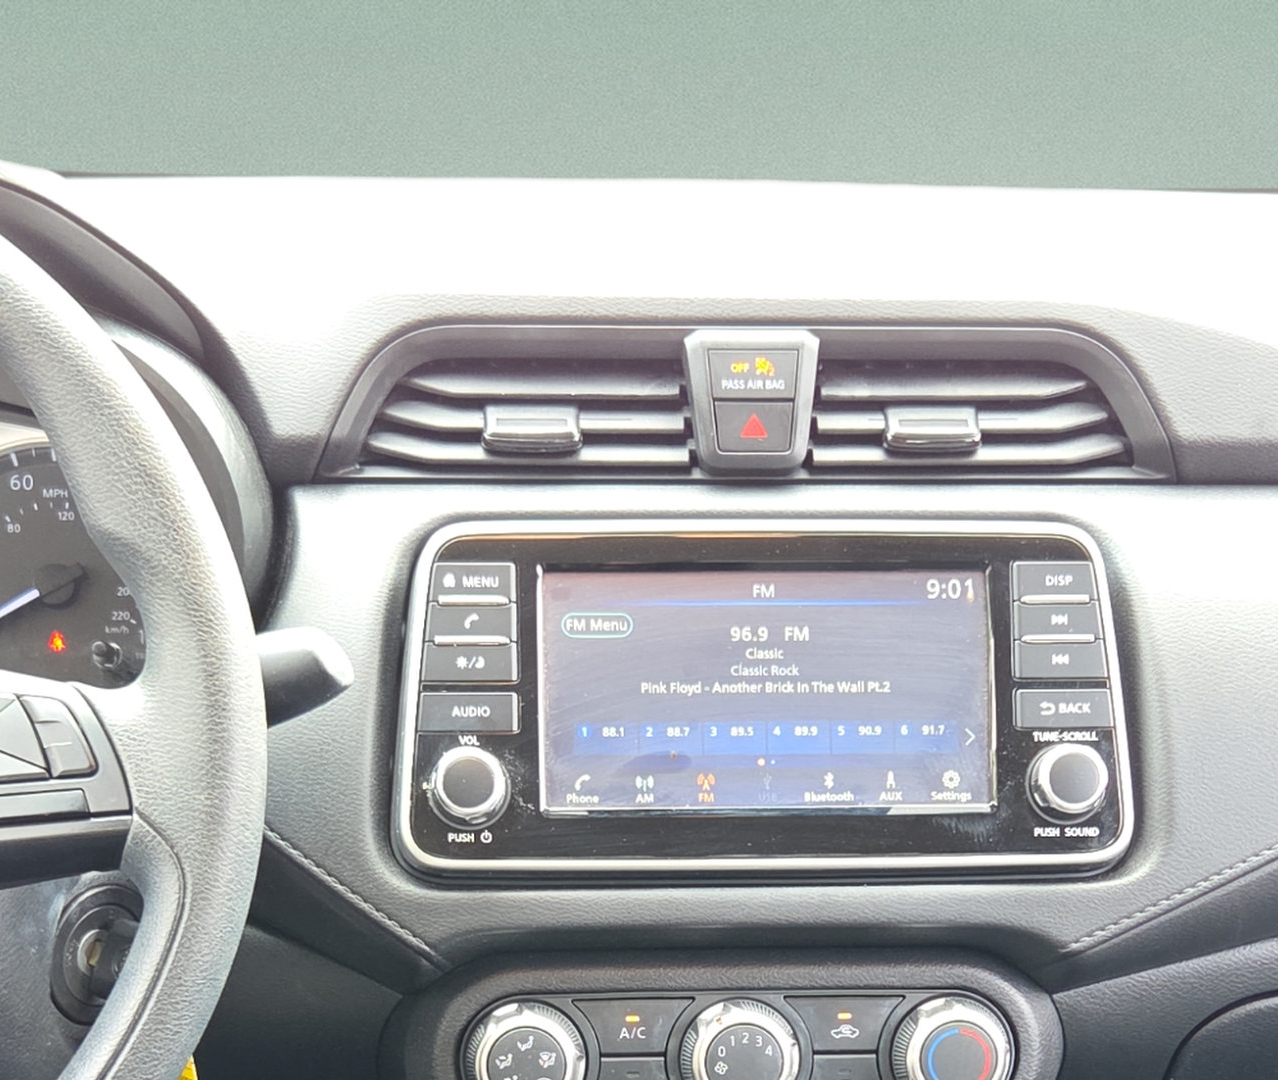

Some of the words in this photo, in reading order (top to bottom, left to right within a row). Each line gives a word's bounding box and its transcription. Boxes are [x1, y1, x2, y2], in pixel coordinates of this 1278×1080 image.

[731, 362, 750, 373] OFF
[721, 379, 745, 390] PASS
[747, 379, 764, 390] AIR
[765, 379, 785, 390] BAG
[10, 475, 33, 490] 60
[43, 488, 68, 498] MPH
[58, 511, 74, 521] 120
[7, 524, 21, 533] 80
[462, 576, 499, 588] MENU
[1045, 575, 1073, 587] DISP
[753, 584, 775, 598] FM
[926, 579, 974, 600] 9:01
[112, 611, 130, 621] 220
[566, 619, 586, 632] FM
[590, 619, 628, 632] Menu
[730, 626, 768, 642] 96.9
[784, 626, 809, 642] FM
[745, 648, 784, 660] Classic
[731, 665, 768, 676] Classic
[771, 665, 799, 676] Rock
[641, 682, 667, 694] Pink
[670, 682, 701, 696] Floyd
[712, 681, 762, 694] Another
[765, 681, 794, 693] Brick
[797, 681, 809, 693] In
[812, 681, 834, 693] The
[836, 681, 864, 693] Wall
[452, 706, 491, 718] AUDIO
[1058, 702, 1091, 714] BACK
[582, 727, 587, 737] 1
[602, 727, 624, 737] 88.1
[646, 727, 652, 737] 2
[666, 727, 690, 737] 88.7
[710, 727, 717, 737] 3
[730, 726, 754, 737] 89.5
[773, 727, 781, 736] 4
[794, 726, 818, 736] 89.9
[838, 727, 845, 736] 5
[858, 726, 882, 736] 90.9
[900, 726, 908, 736] 6
[922, 725, 945, 735] 91.7
[459, 735, 479, 746] VOL
[566, 793, 599, 804] Phone
[635, 793, 654, 804] AM
[698, 793, 714, 803] FM
[804, 792, 854, 802] Bluetooth
[879, 792, 902, 802] AUX
[931, 791, 972, 803] Settings
[448, 832, 474, 843] PUSH
[1034, 827, 1060, 838] PUSH
[1064, 827, 1099, 838] SOUND
[620, 1026, 646, 1039] A/C
[742, 1032, 749, 1044] 2
[730, 1036, 735, 1046] 1
[755, 1036, 763, 1047] 3
[718, 1046, 726, 1057] 0
[765, 1045, 772, 1056] 4
